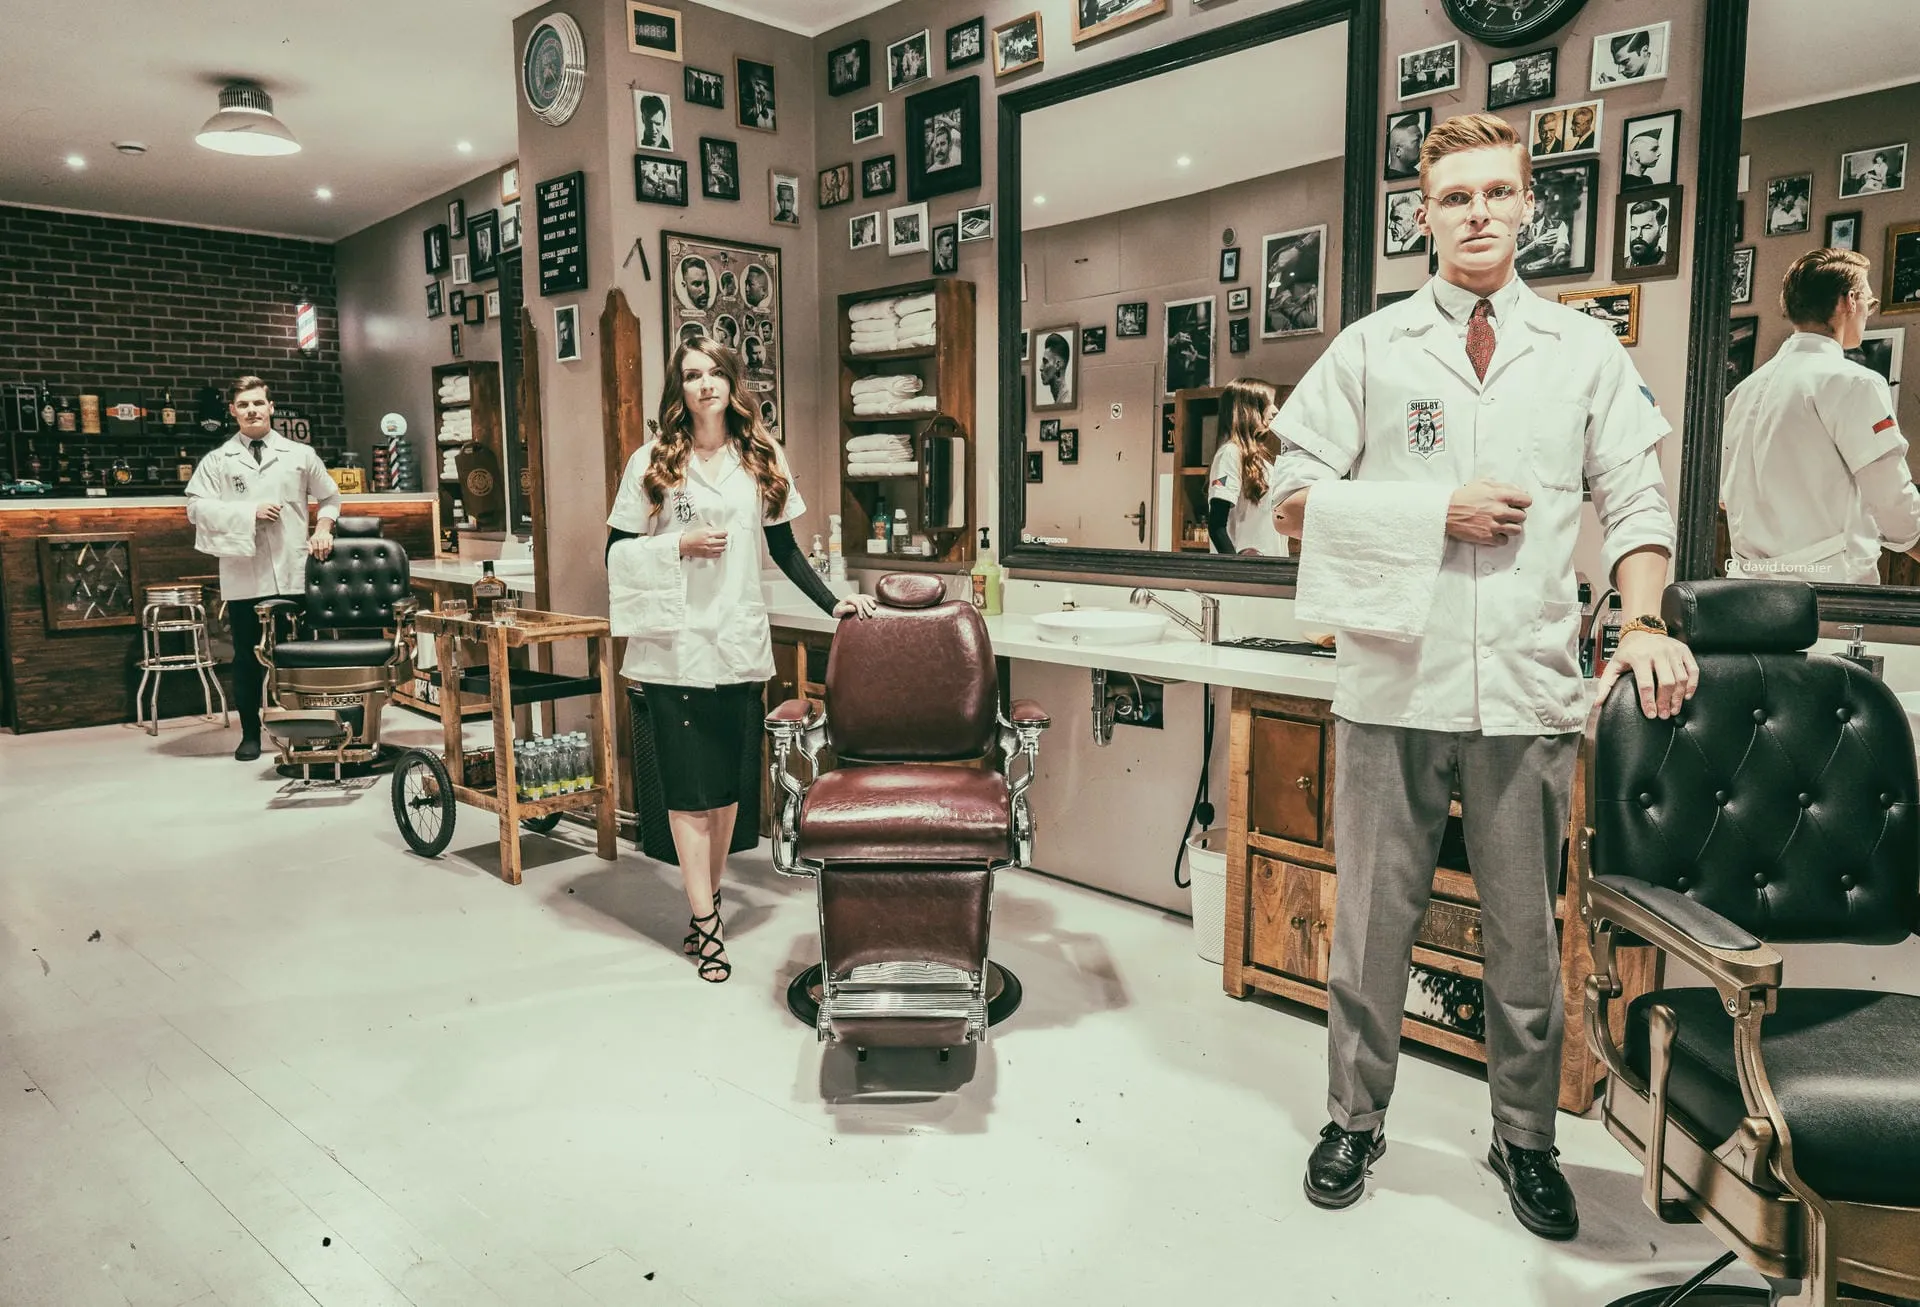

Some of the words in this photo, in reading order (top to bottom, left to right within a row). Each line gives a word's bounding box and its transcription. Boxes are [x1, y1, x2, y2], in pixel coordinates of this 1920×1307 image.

[1486, 6, 1497, 20] 7
[1512, 6, 1522, 20] 6
[1410, 402, 1438, 410] SHELBY
[280, 421, 307, 440] 10
